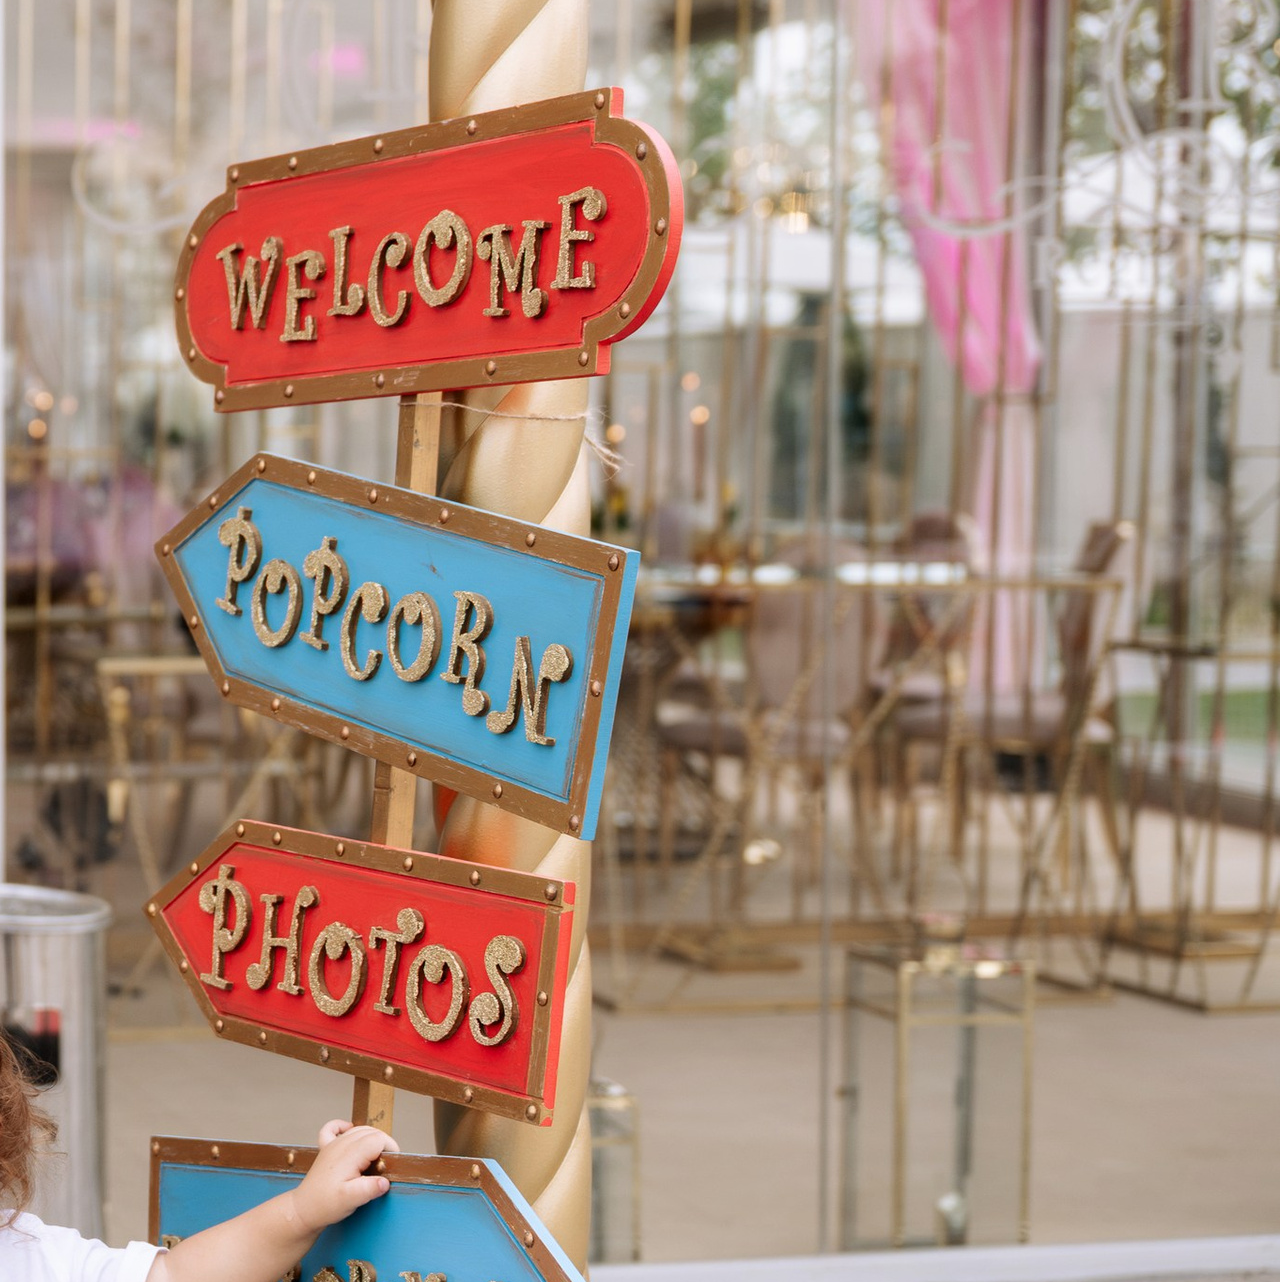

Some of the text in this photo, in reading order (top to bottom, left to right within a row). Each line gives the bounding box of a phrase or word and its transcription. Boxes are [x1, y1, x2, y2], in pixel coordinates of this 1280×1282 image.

[216, 186, 607, 342] WELCOME
[215, 506, 574, 746] POPCORN
[198, 864, 526, 1047] PHOTOS
